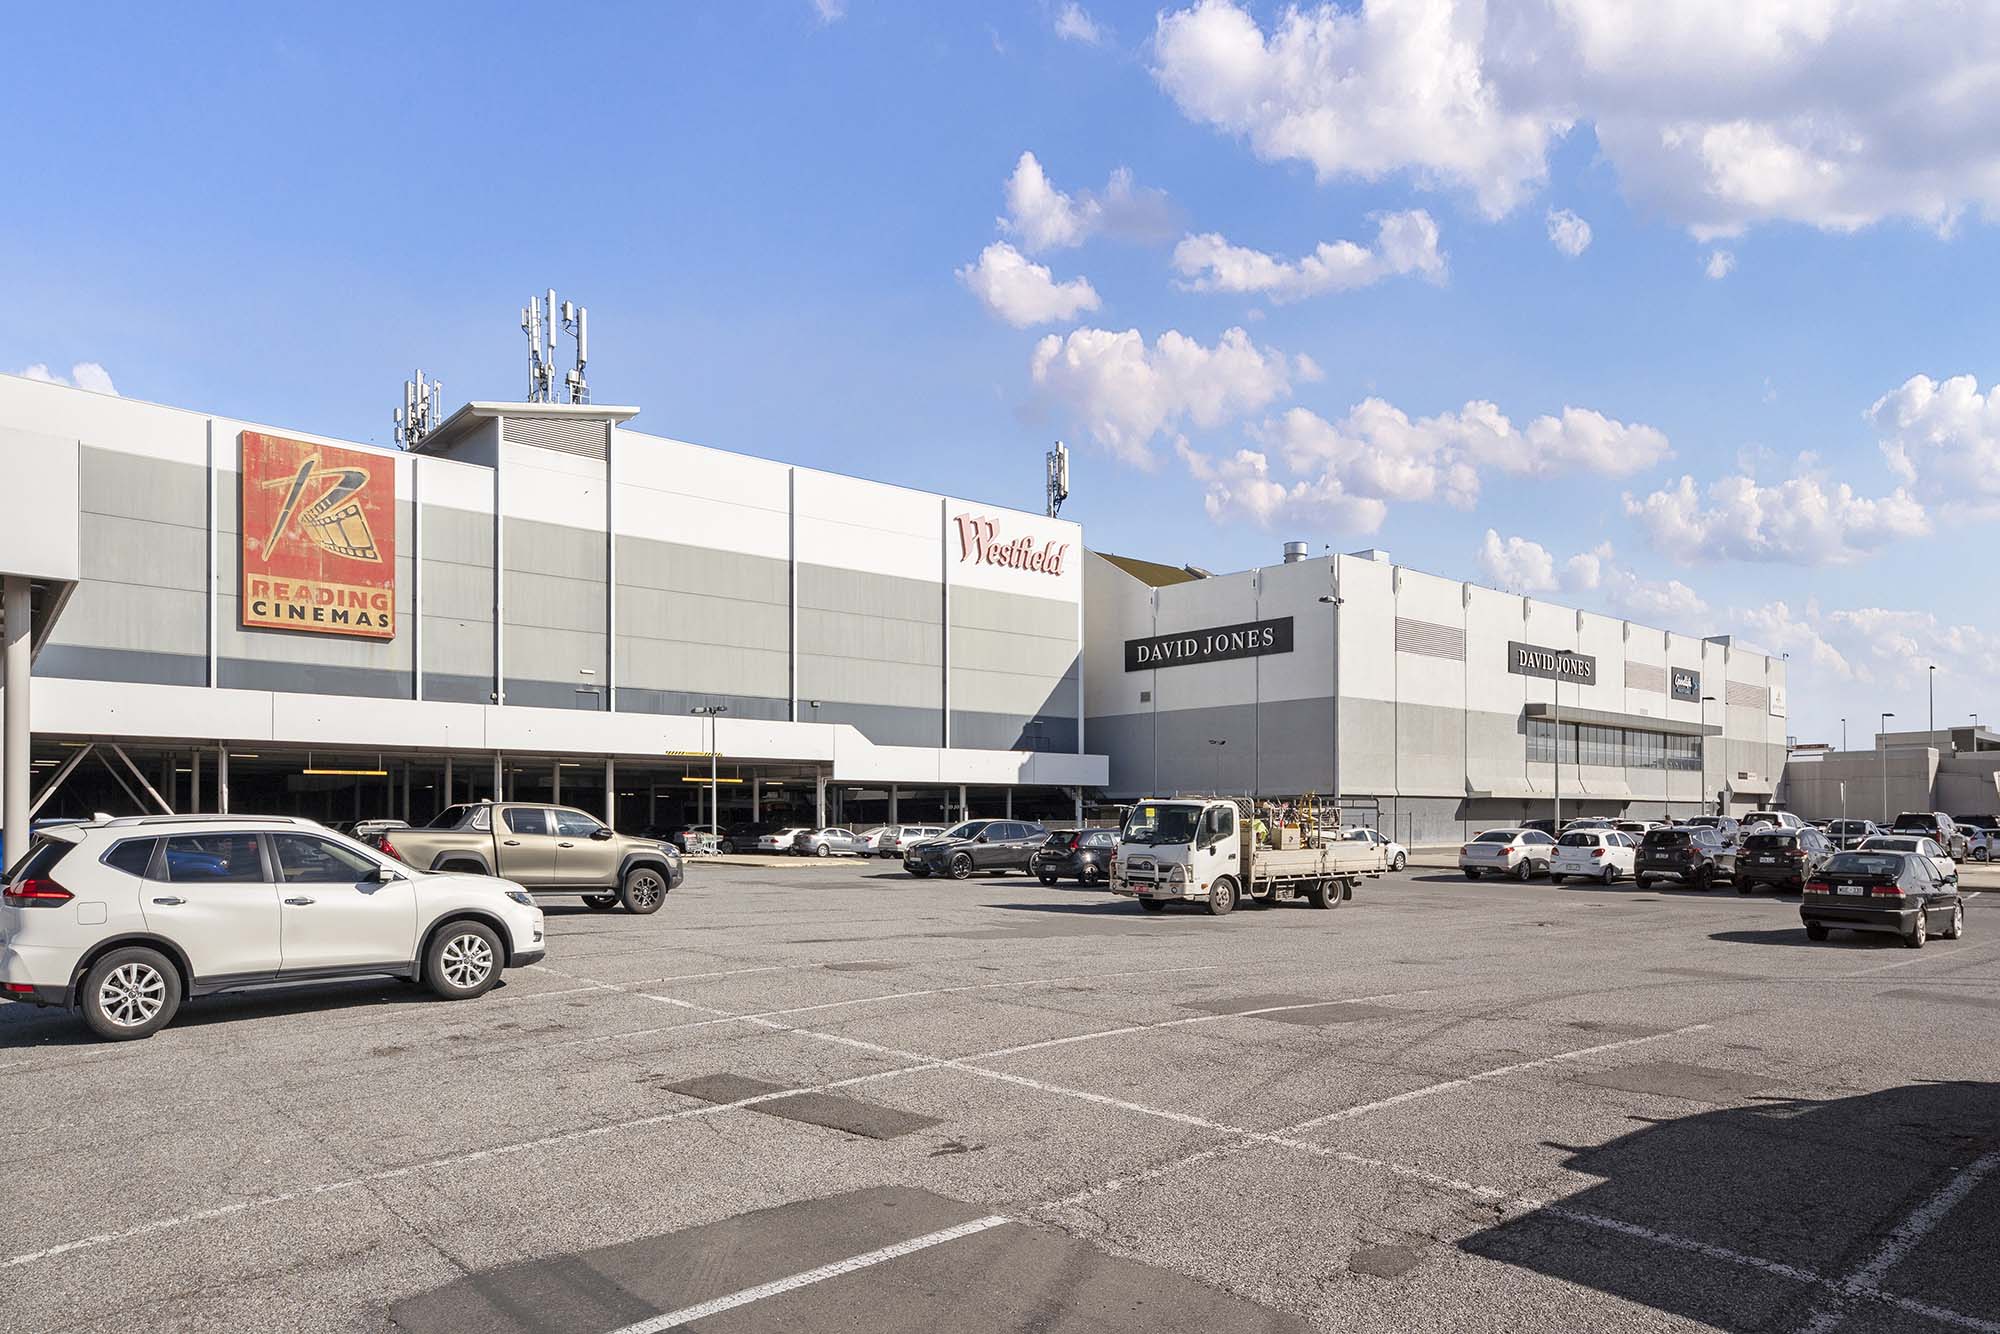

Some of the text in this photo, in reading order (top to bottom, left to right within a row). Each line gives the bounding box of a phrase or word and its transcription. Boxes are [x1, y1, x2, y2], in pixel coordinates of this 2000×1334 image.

[953, 512, 1070, 576] Westfield
[251, 579, 388, 611] READING
[252, 600, 388, 627] CINEMAS
[1137, 627, 1274, 663] DAVID JONES
[1518, 649, 1591, 677] DAVID JONES
